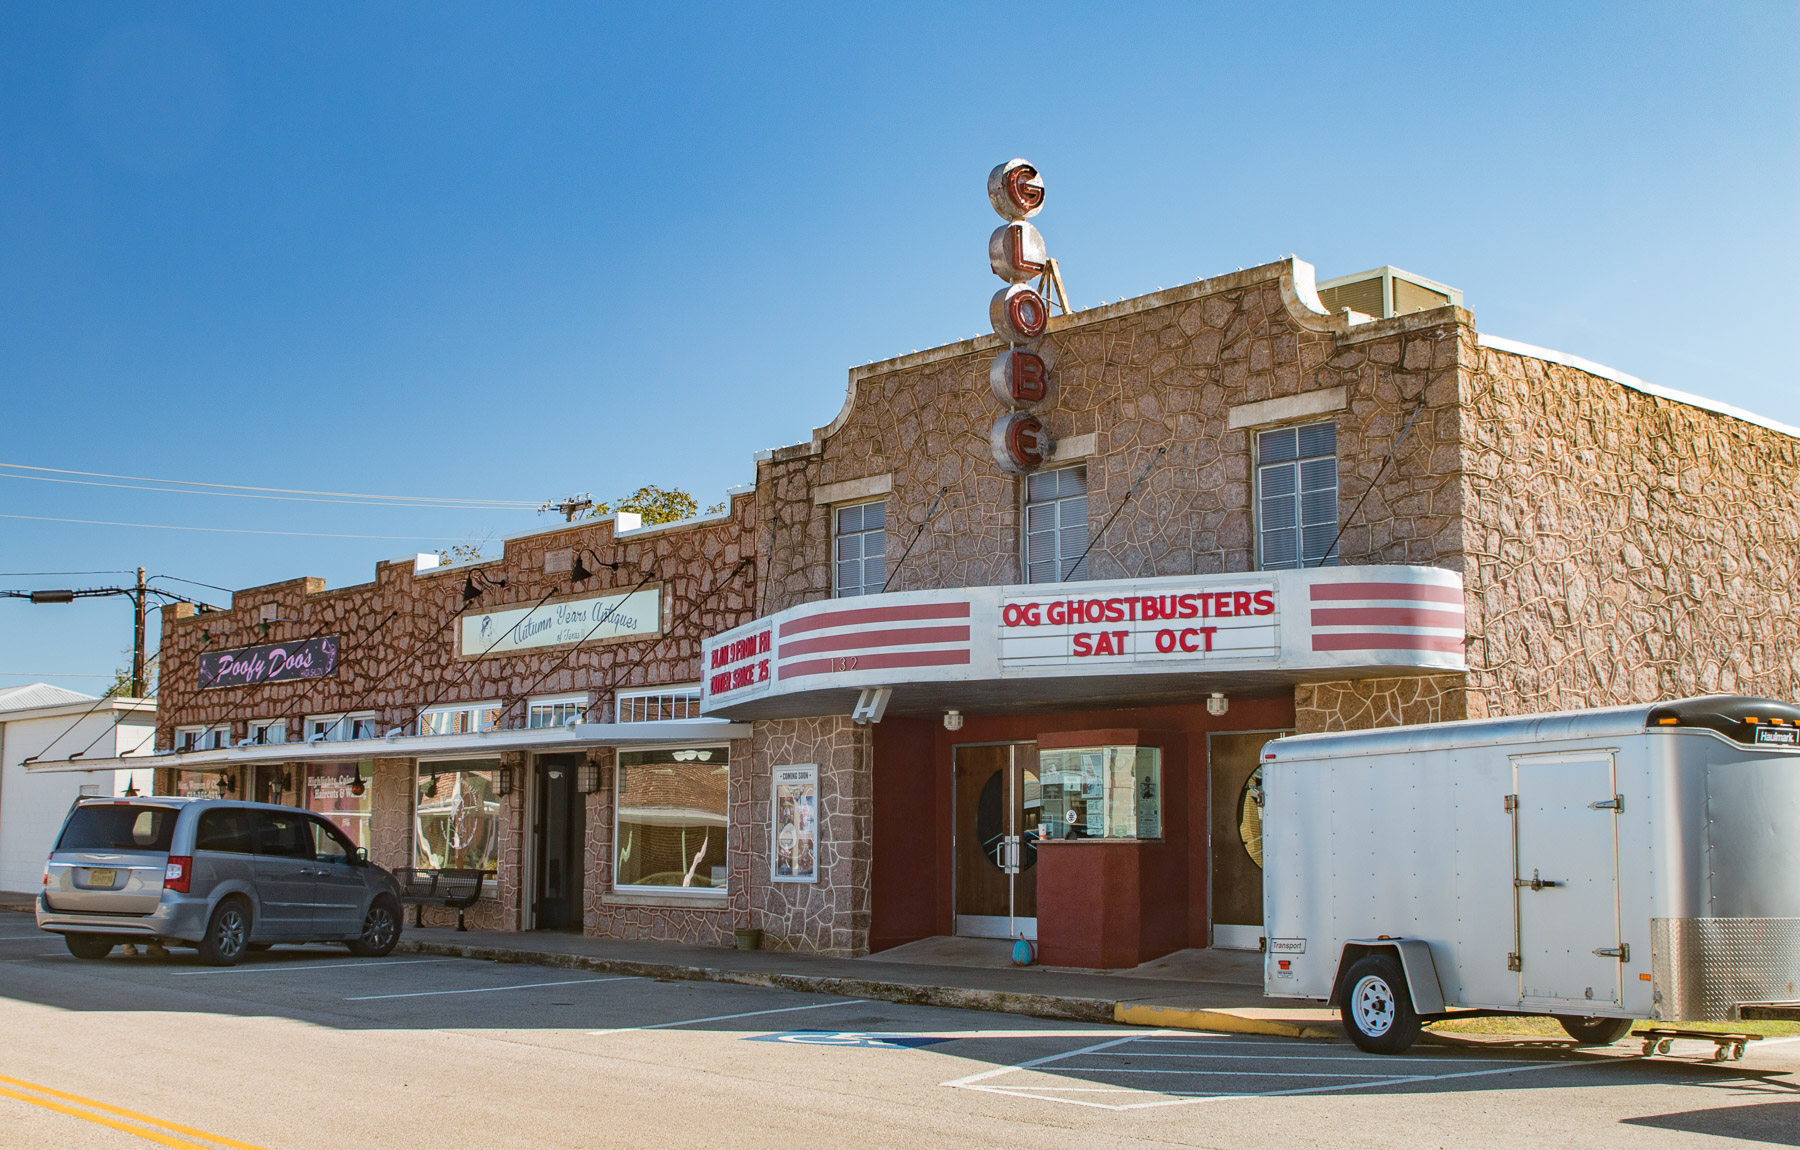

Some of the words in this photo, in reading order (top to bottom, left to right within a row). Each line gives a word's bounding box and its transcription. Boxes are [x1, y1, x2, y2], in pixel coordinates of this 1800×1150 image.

[1004, 162, 1048, 467] GLOBE
[513, 617, 552, 645] Autumn
[556, 605, 587, 625] Years
[591, 602, 638, 633] Antiques
[1003, 603, 1041, 627] OG
[1047, 590, 1275, 625] GHOSTBUSTERS
[711, 645, 729, 670] PLAN
[729, 642, 735, 663] 9
[735, 634, 756, 661] FROM
[758, 629, 770, 653] FRI
[1073, 630, 1129, 657] SAT
[1155, 626, 1217, 653] OCT
[216, 652, 266, 683] Poofy
[268, 648, 314, 678] Doo's
[711, 671, 731, 695] OUTER
[732, 664, 754, 689] SPACE
[758, 658, 769, 682] 25
[830, 656, 858, 673] 132
[1760, 731, 1795, 743] Haulmark
[782, 772, 798, 780] COMING
[798, 771, 808, 780] SOON
[1273, 941, 1302, 951] Transport
